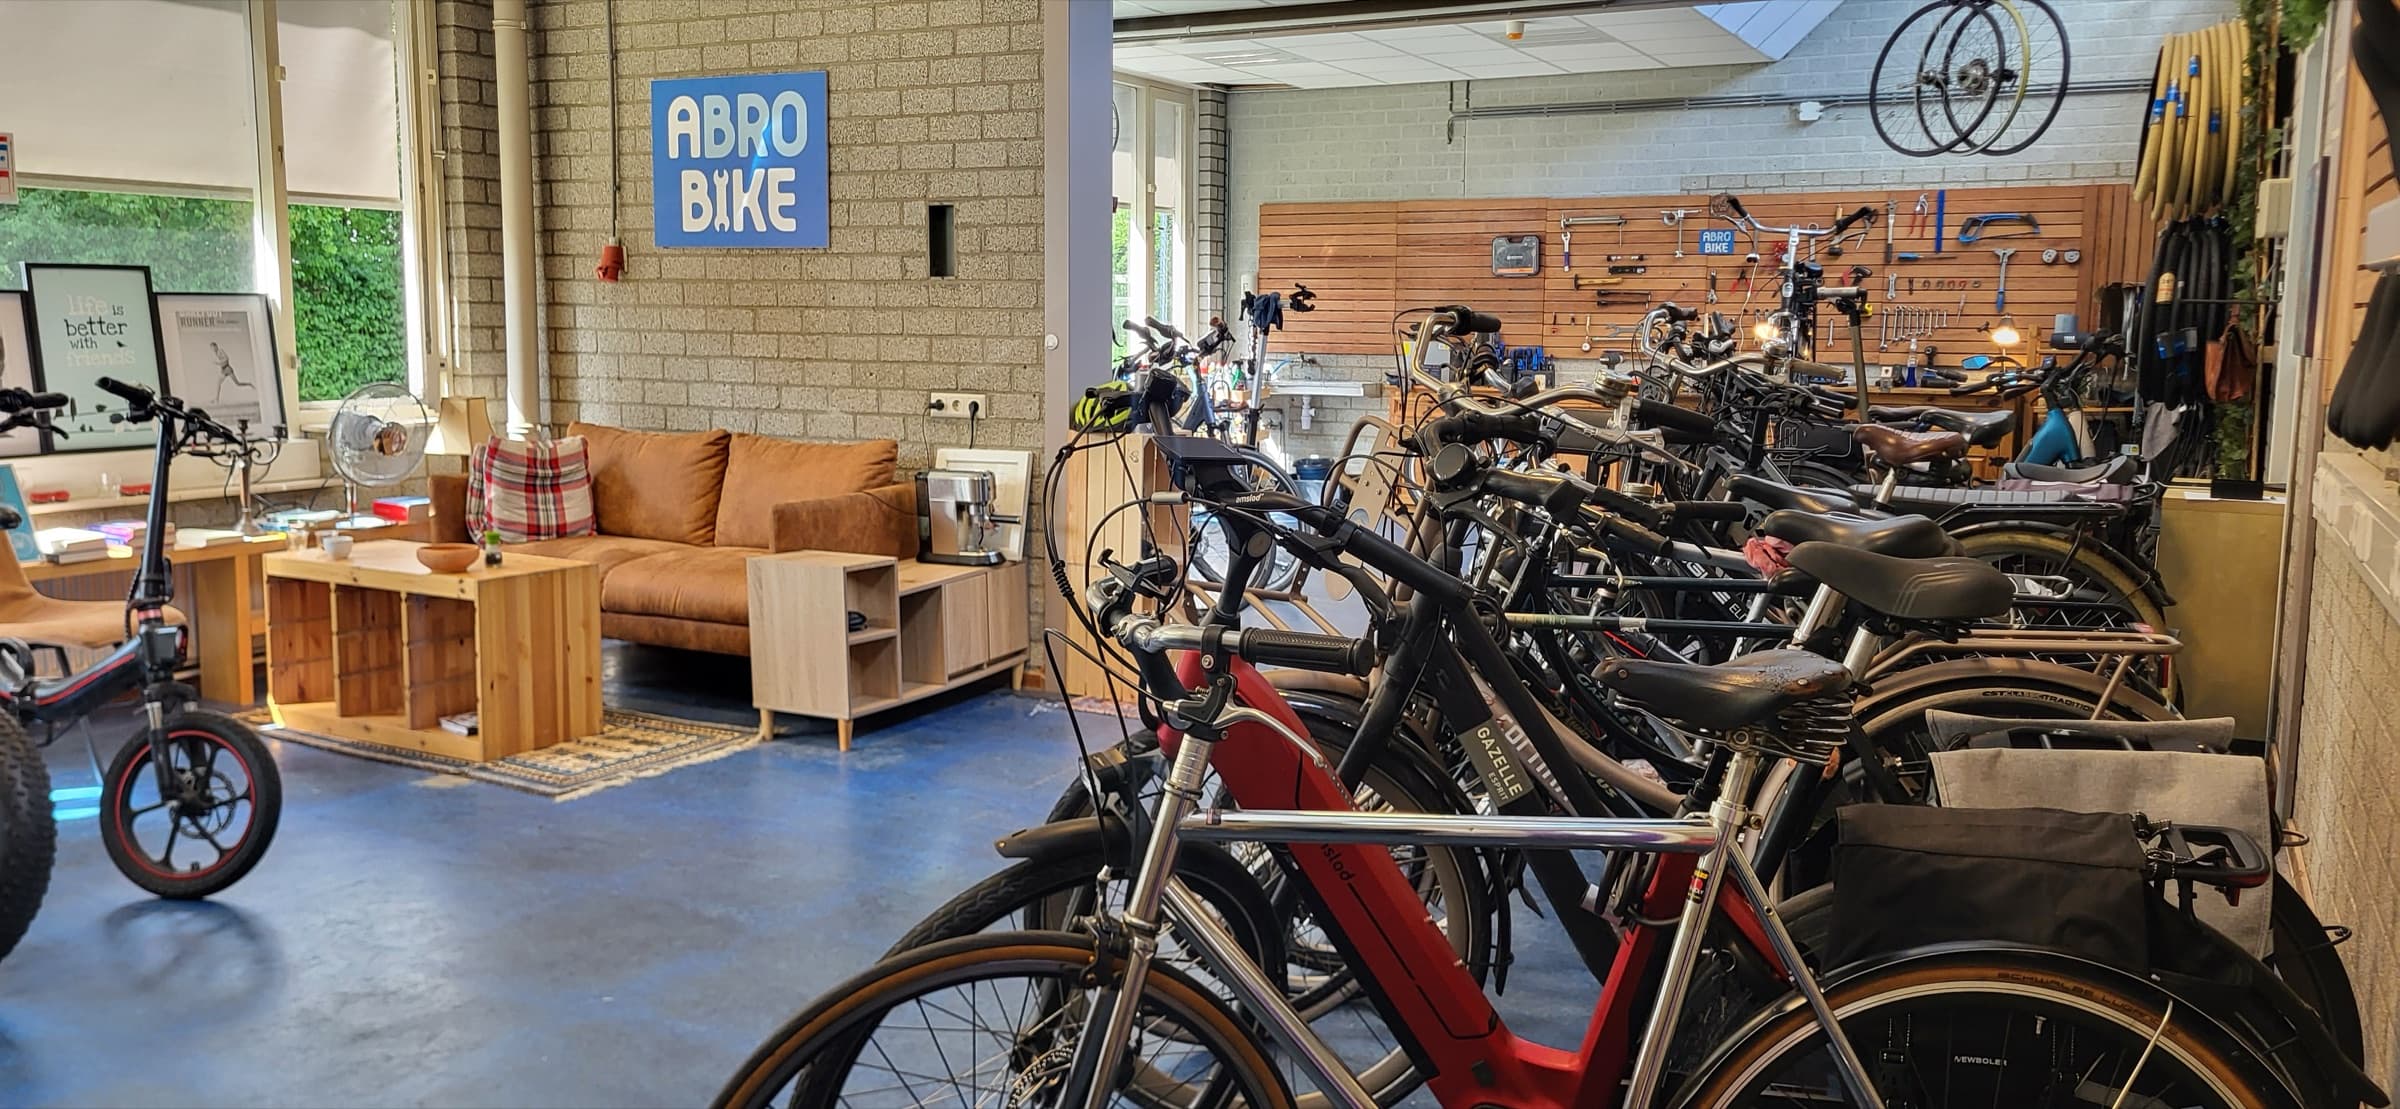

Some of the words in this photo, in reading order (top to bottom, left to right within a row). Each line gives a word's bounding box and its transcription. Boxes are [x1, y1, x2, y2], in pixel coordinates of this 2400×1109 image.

[668, 90, 808, 159] ABRO
[681, 167, 797, 232] BIKE
[1703, 231, 1732, 242] ABRO
[1704, 242, 1729, 253] BIKE
[65, 293, 108, 316] life
[64, 315, 128, 336] better
[180, 317, 215, 328] RUNNER
[70, 337, 98, 349] with
[1477, 727, 1523, 796] GAZELLE
[1488, 772, 1508, 801] ESPRIT
